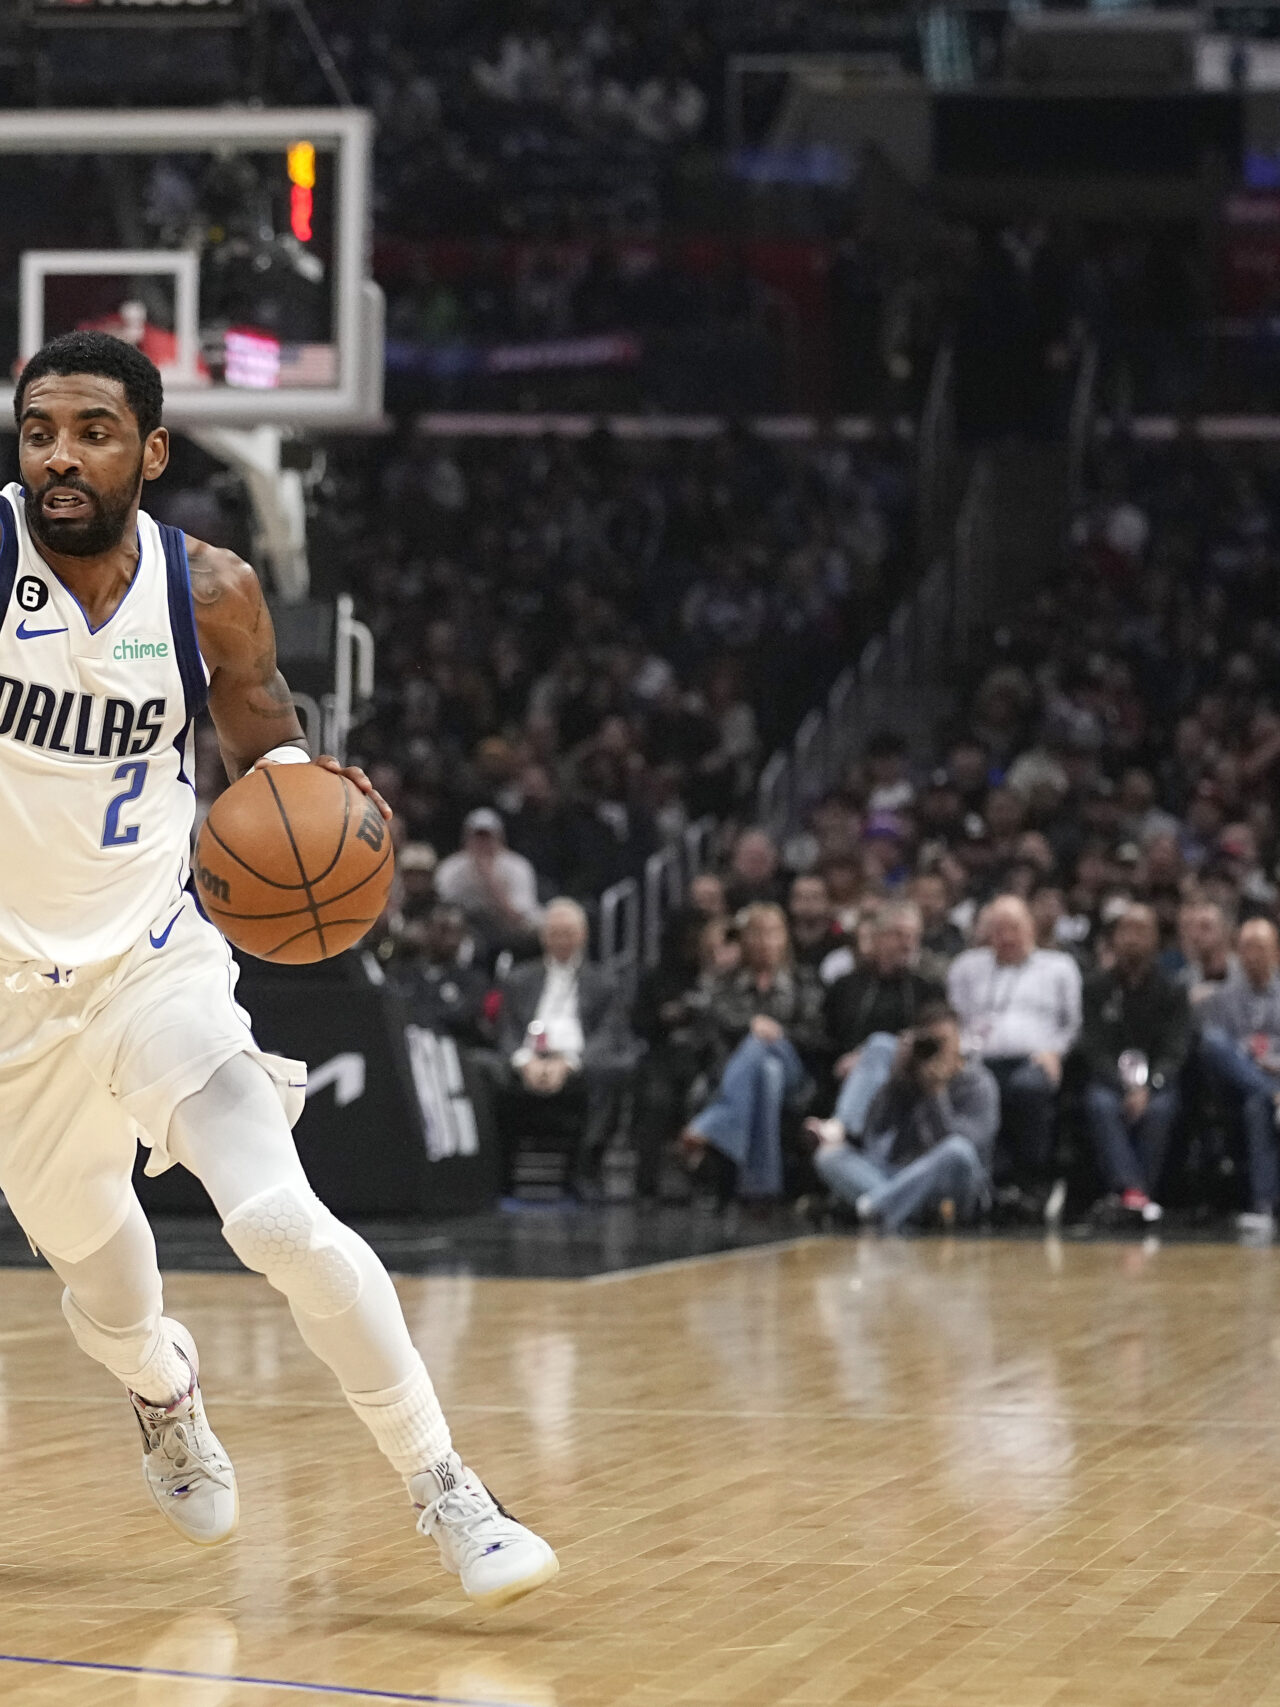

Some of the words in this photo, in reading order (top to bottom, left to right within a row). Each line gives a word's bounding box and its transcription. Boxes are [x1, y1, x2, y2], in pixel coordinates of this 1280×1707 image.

[21, 580, 40, 608] 6
[113, 638, 168, 660] chime
[100, 759, 149, 849] 2
